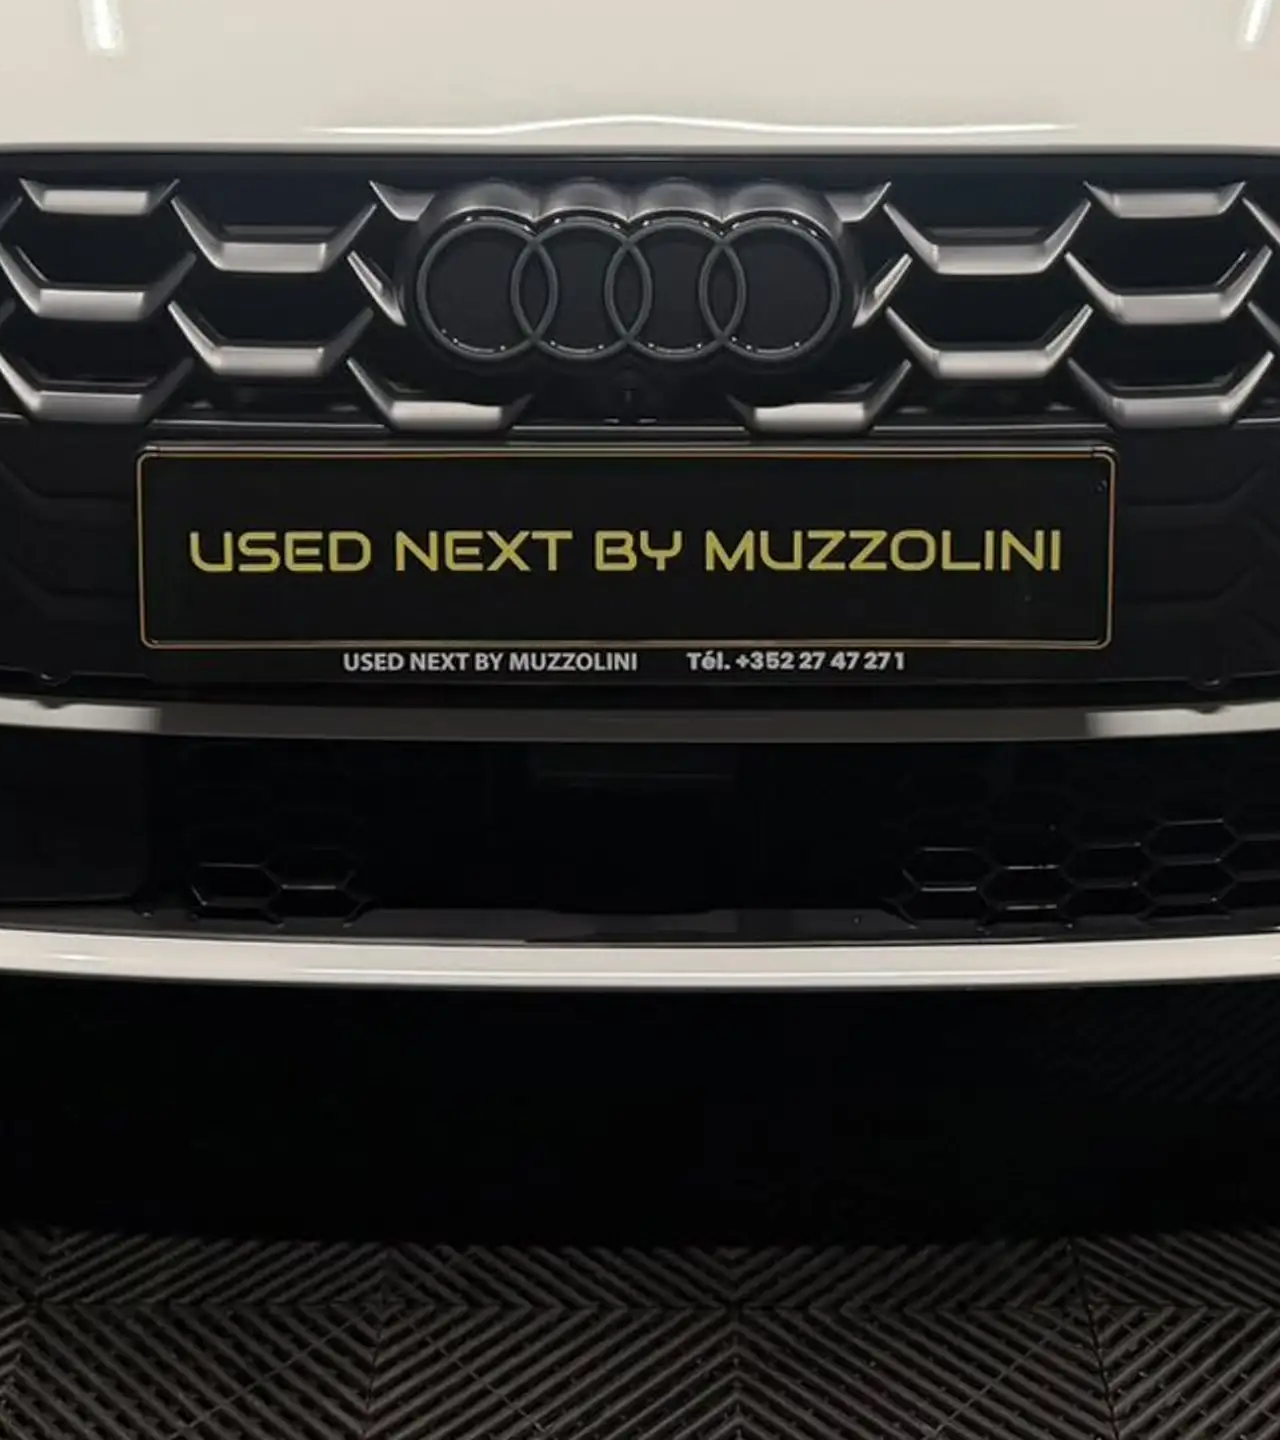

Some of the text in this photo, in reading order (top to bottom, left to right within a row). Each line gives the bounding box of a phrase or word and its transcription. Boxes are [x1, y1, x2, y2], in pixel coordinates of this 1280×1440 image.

[189, 530, 1061, 572] USED NEXT BY MUZZOLINI
[343, 652, 638, 672] USED NEXT BY MUZZOLINI
[686, 650, 731, 671] Tél.
[735, 651, 795, 671] +352
[798, 651, 826, 671] 27
[829, 651, 860, 671] 47
